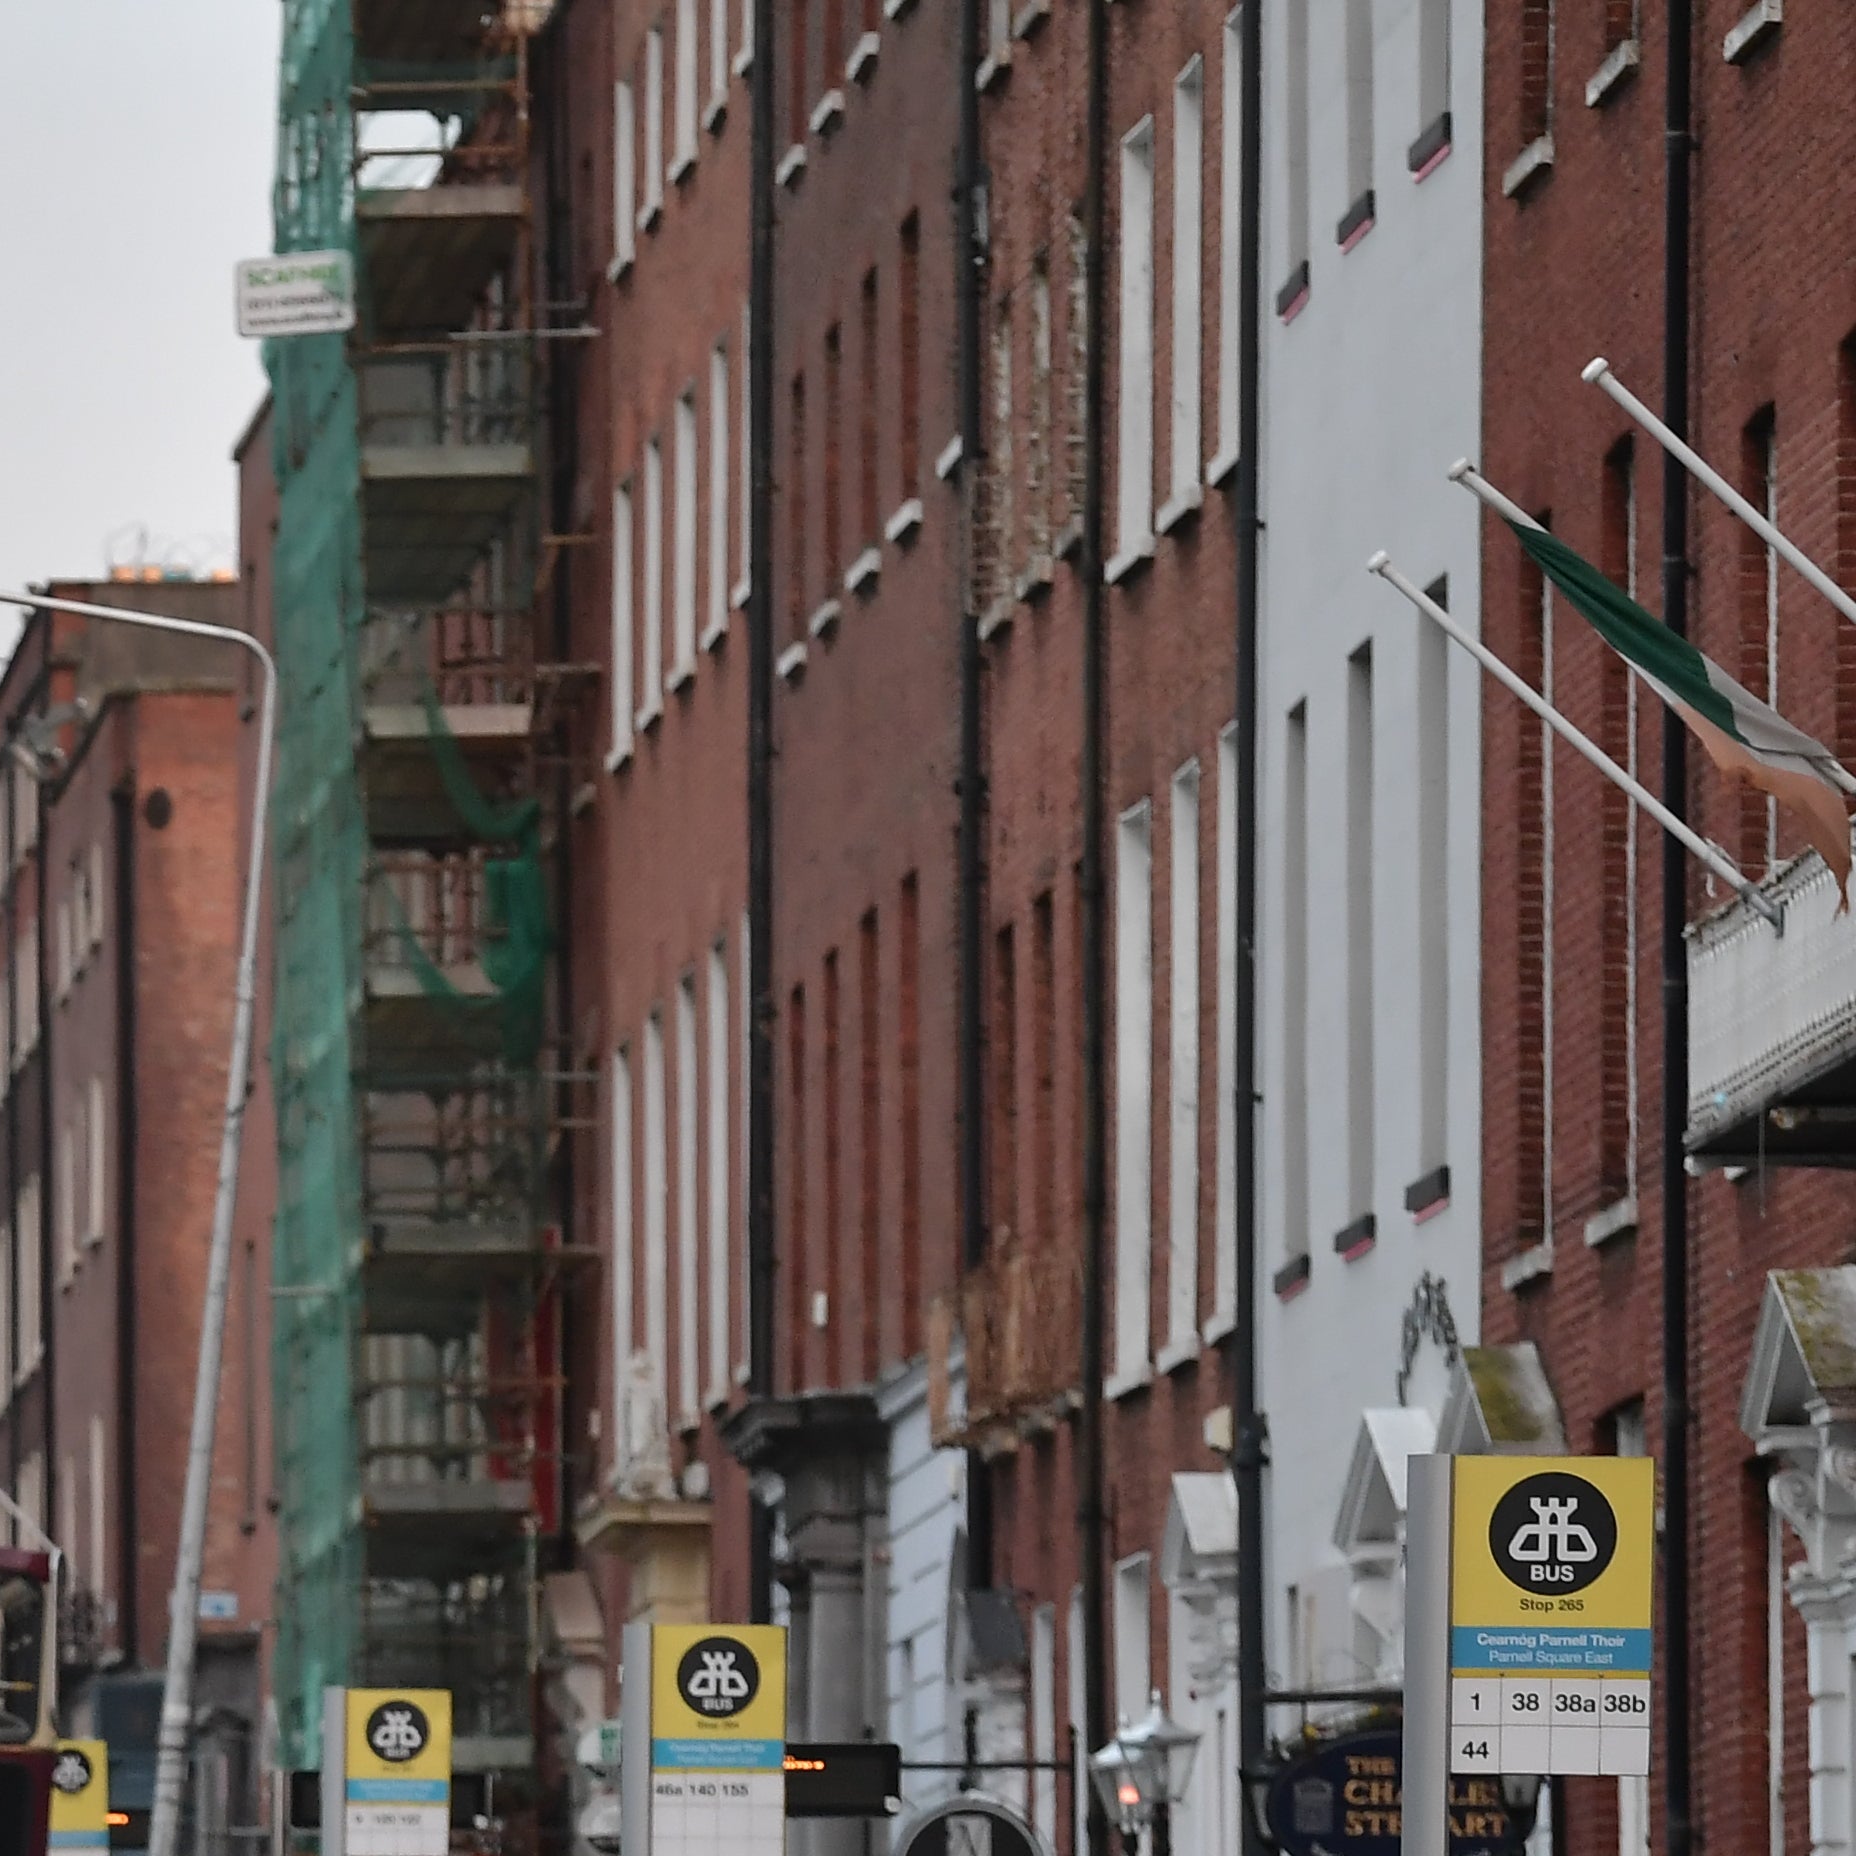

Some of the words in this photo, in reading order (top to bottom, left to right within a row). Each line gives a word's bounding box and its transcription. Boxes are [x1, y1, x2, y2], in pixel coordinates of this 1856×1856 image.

[1530, 1565, 1575, 1582] BUS
[1519, 1599, 1554, 1613] Stop
[1558, 1600, 1585, 1612] 265
[1477, 1632, 1536, 1649] Cearnóg
[1540, 1633, 1588, 1646] Parnell
[1590, 1634, 1626, 1647] Thoir
[1489, 1651, 1533, 1663] Parnell
[1536, 1651, 1582, 1666] Square
[1585, 1652, 1613, 1664] East
[1470, 1692, 1480, 1711] 1
[1511, 1693, 1540, 1712] 38
[1554, 1694, 1596, 1713] 38a
[1604, 1694, 1646, 1713] 38b
[1461, 1740, 1489, 1759] 44
[689, 1785, 717, 1796] 140
[722, 1785, 749, 1797] 155
[1344, 1777, 1500, 1807] CHLE
[1344, 1810, 1508, 1838] STERT
